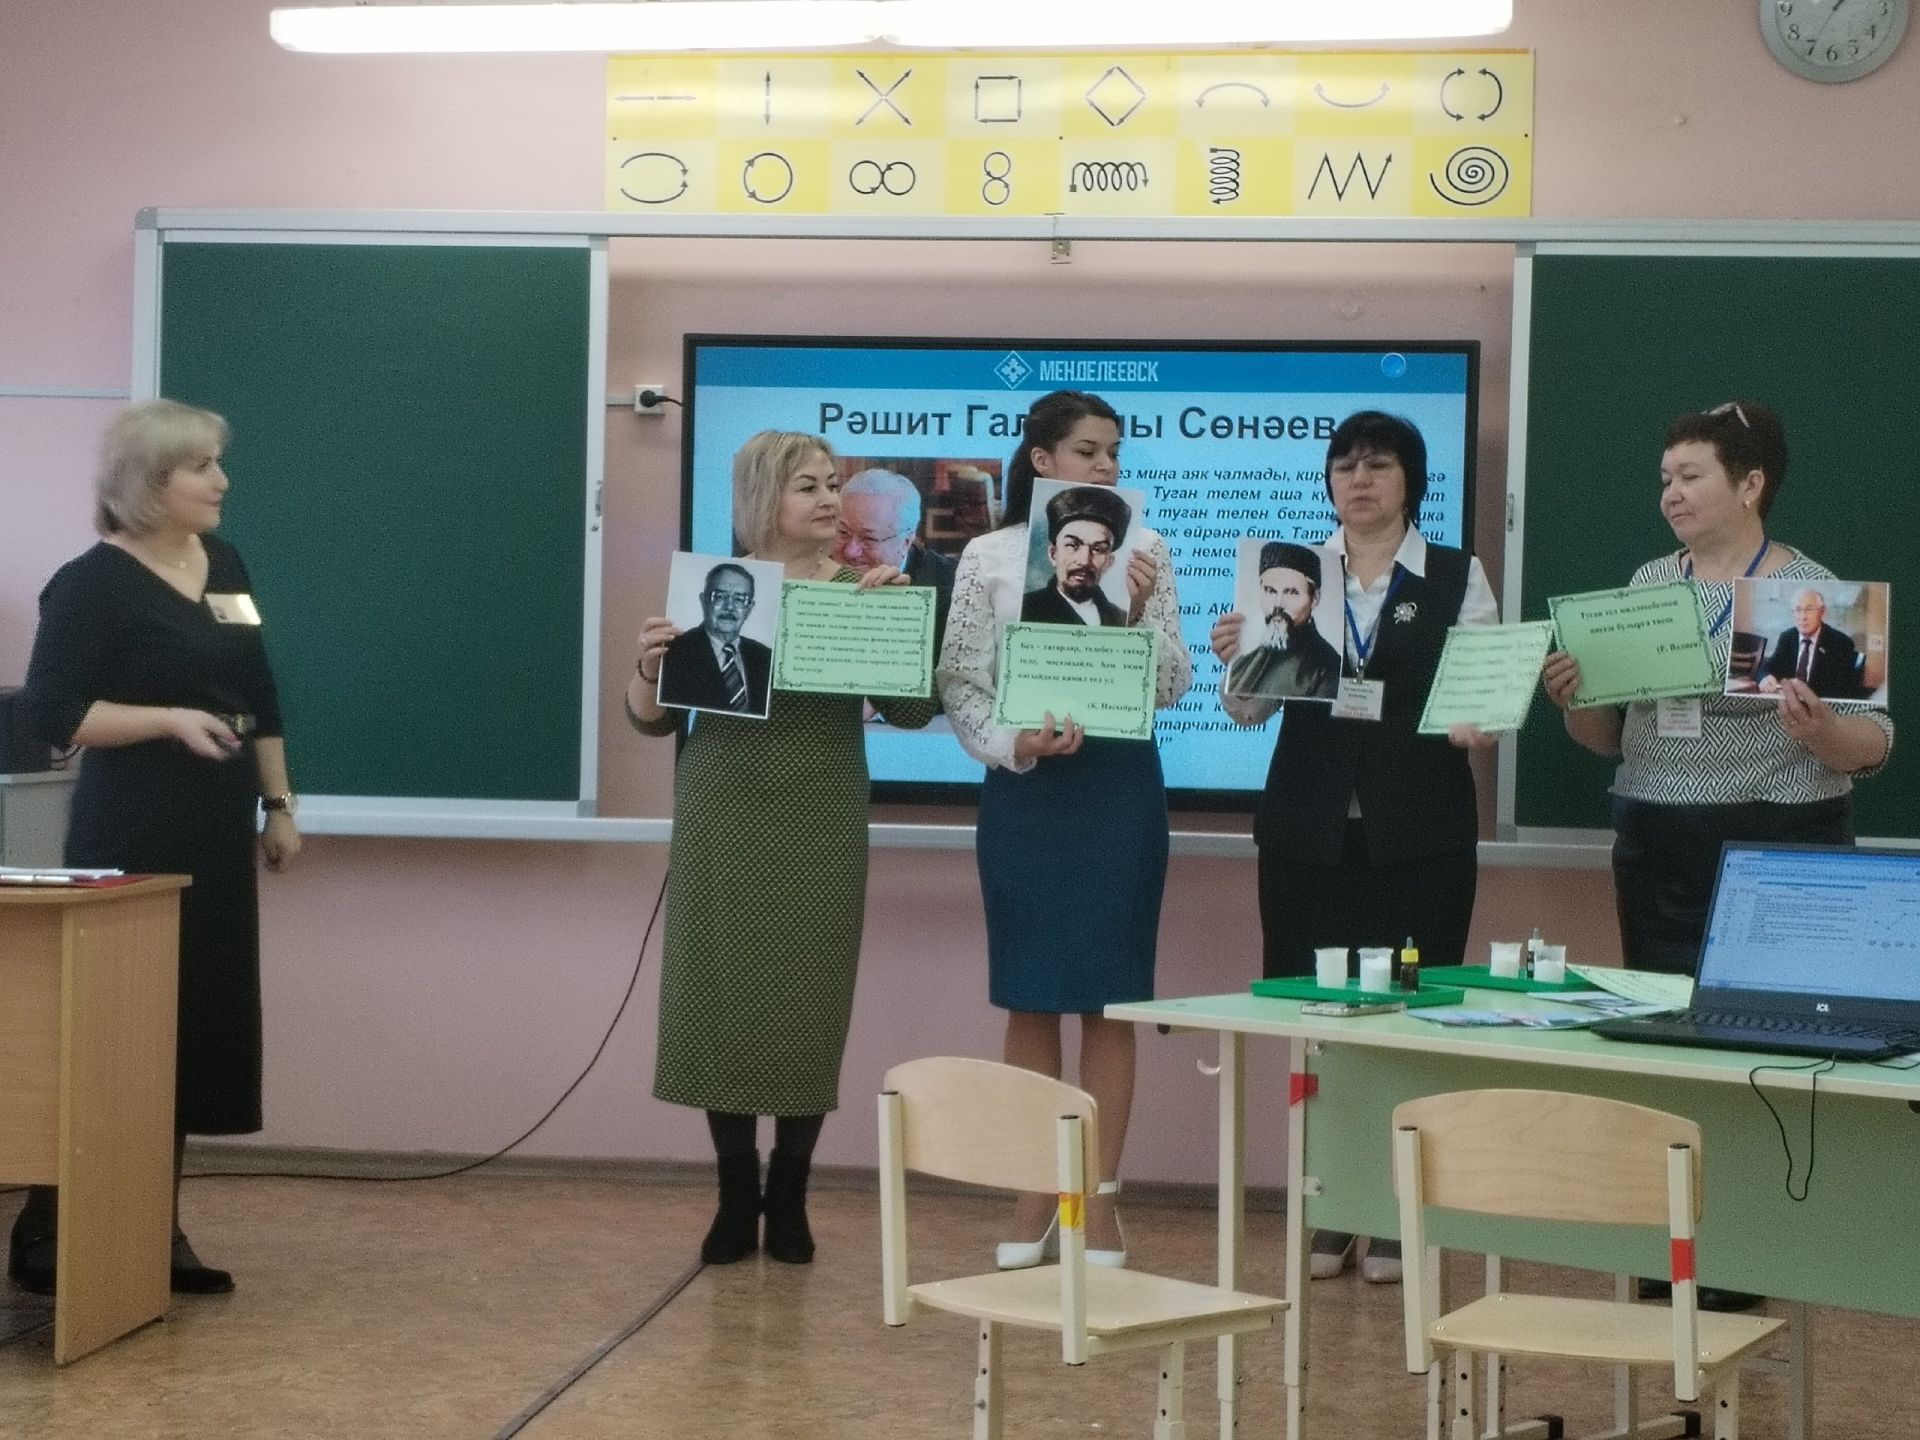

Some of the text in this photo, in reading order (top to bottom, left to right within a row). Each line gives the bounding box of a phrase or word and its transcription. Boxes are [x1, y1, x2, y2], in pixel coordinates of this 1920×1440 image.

[1788, 23, 1800, 40] 8
[1806, 39, 1818, 56] 7
[1826, 44, 1838, 61] 6
[1847, 39, 1859, 55] 5
[1039, 360, 1159, 383] МЕНДЕЛЕЕВСК
[818, 402, 952, 436] Рәшит
[965, 404, 1028, 438] Гал
[1136, 469, 1176, 482] миңа
[1181, 469, 1208, 481] аяк
[1213, 468, 1290, 483] чалмады,
[1153, 485, 1198, 502] Туган
[1206, 489, 1262, 501] телем
[1269, 489, 1303, 501] аша
[1157, 507, 1208, 521] туган
[1216, 508, 1269, 520] телен
[1246, 525, 1284, 540] бит.
[1291, 526, 1334, 541] Тата
